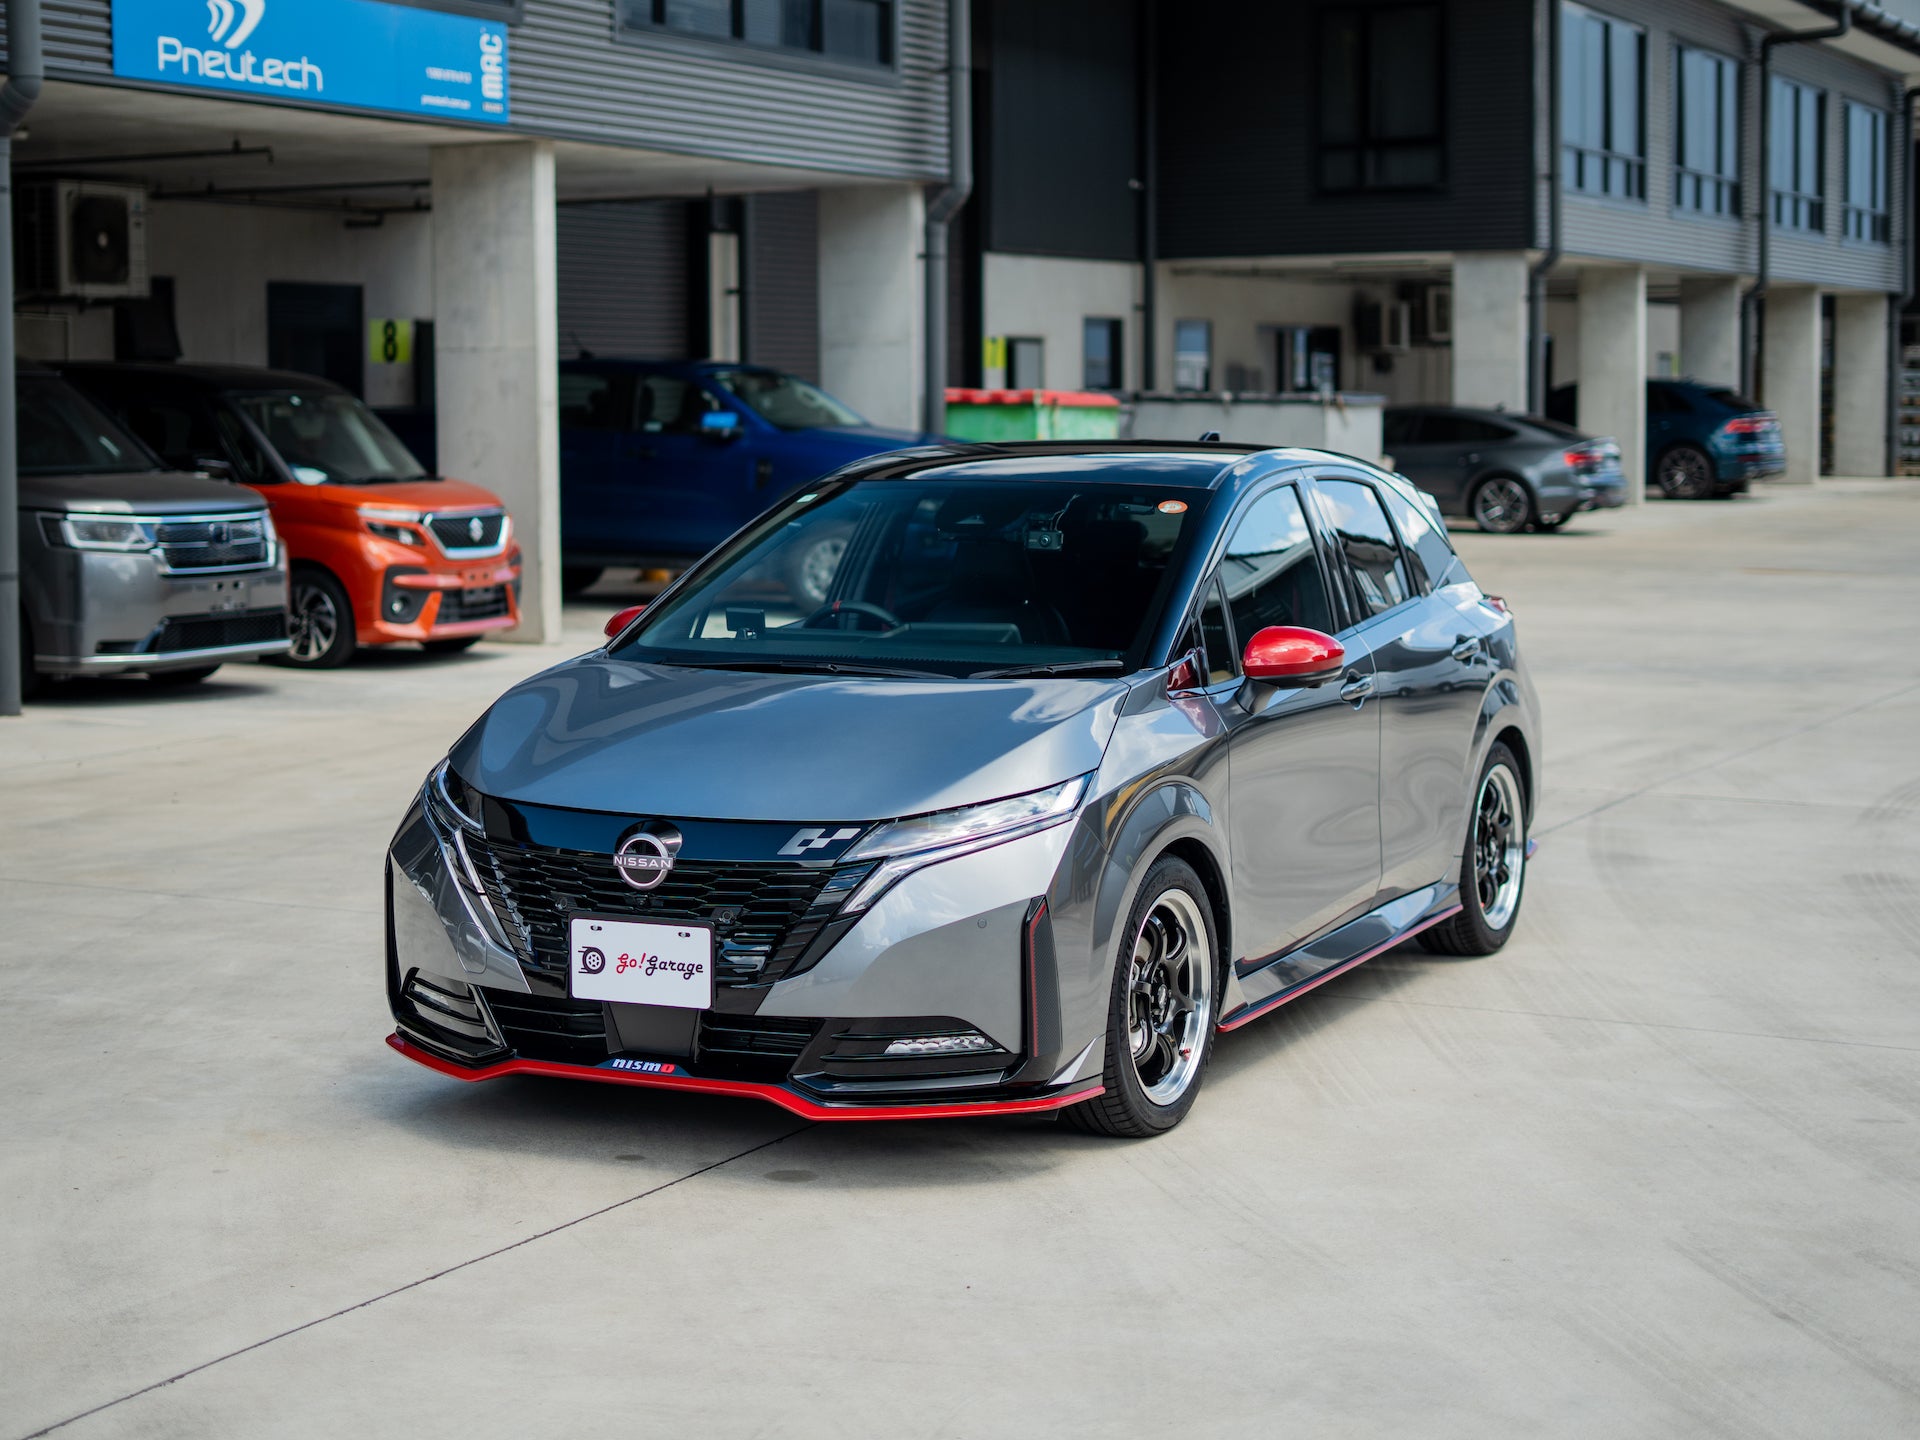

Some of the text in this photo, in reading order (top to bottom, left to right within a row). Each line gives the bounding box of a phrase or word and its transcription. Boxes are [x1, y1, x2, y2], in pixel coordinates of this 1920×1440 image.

[157, 36, 323, 92] Pneutech
[383, 319, 397, 363] 8
[614, 855, 671, 868] NISSAN
